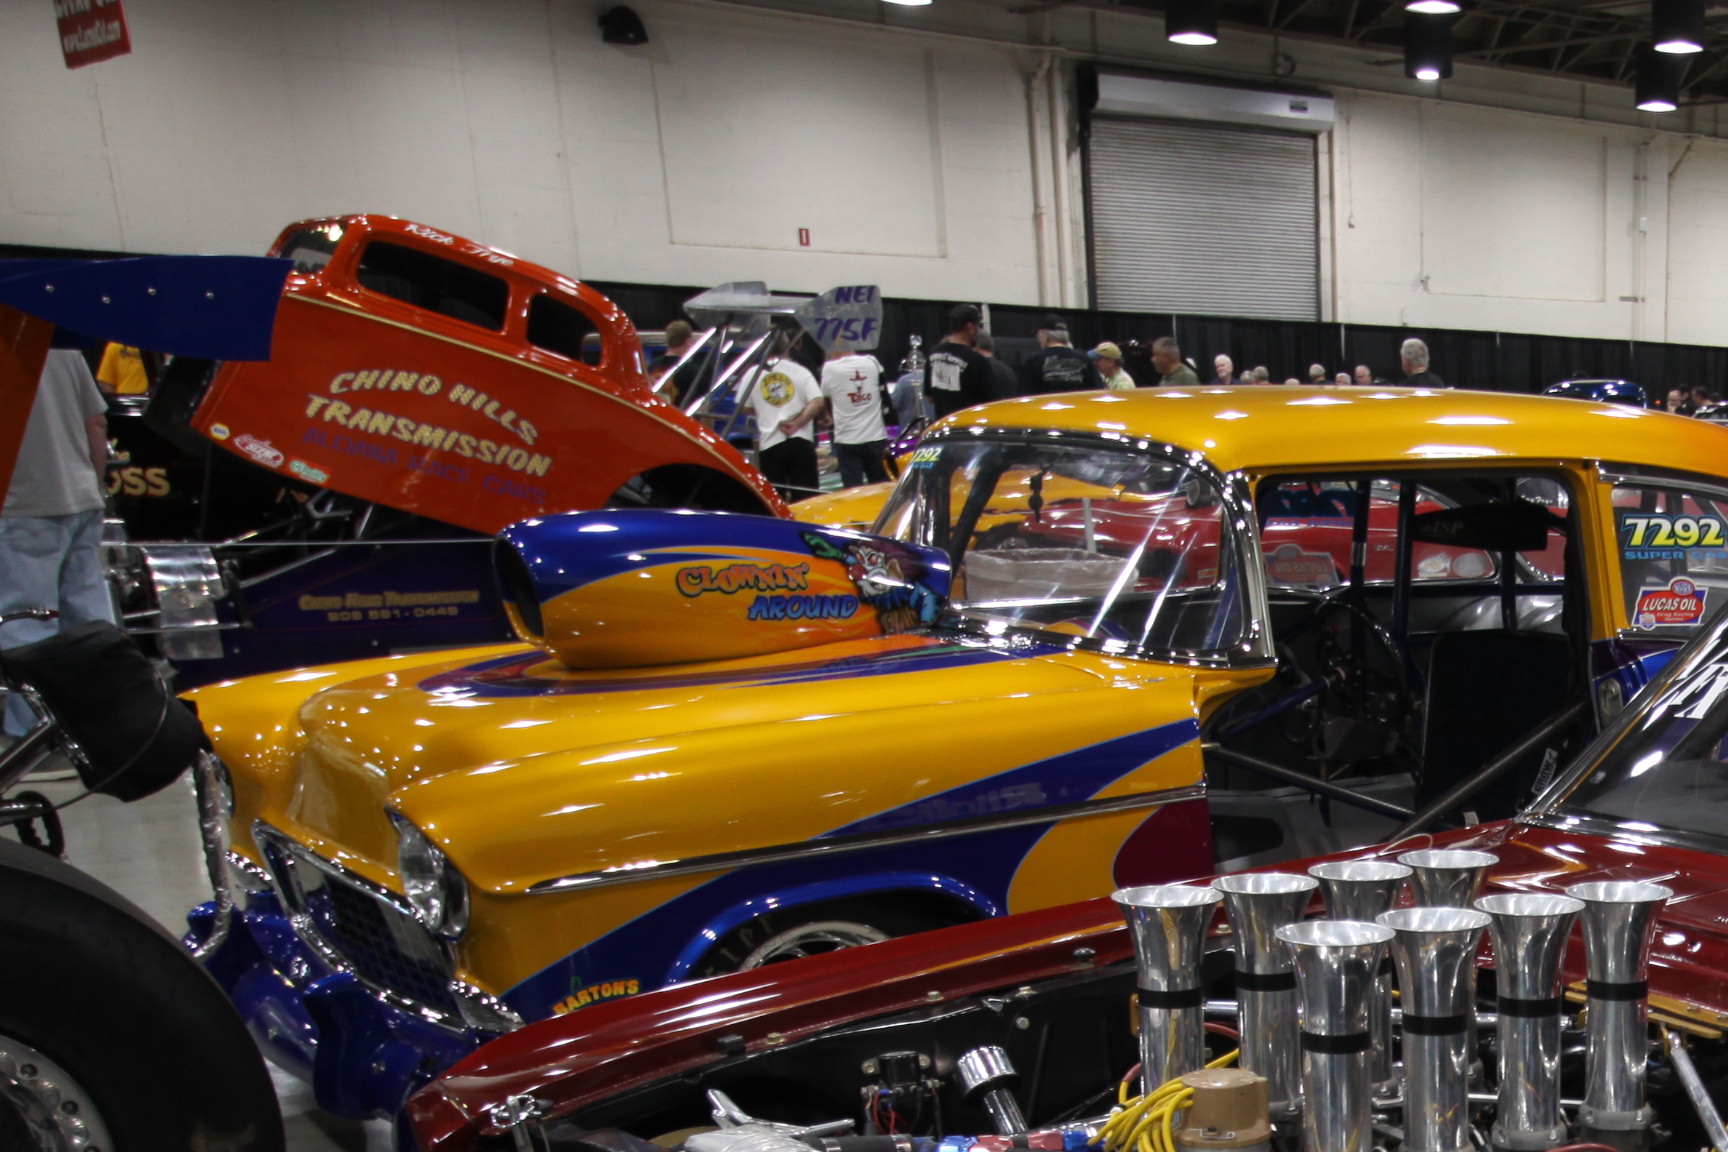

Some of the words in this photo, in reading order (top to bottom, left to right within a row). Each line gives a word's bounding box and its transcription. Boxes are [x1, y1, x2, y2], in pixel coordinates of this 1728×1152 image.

[404, 223, 455, 246] Rick
[328, 368, 443, 396] CHINO
[448, 383, 539, 446] HILLS
[304, 392, 554, 478] TRANSMISSION
[106, 467, 171, 497] OSS
[482, 474, 548, 506] CARS
[1621, 515, 1726, 549] 7292
[1624, 551, 1685, 560] SUPER
[747, 594, 860, 621] AROUND
[1642, 598, 1678, 612] LUCAS
[1680, 598, 1698, 611] OIL
